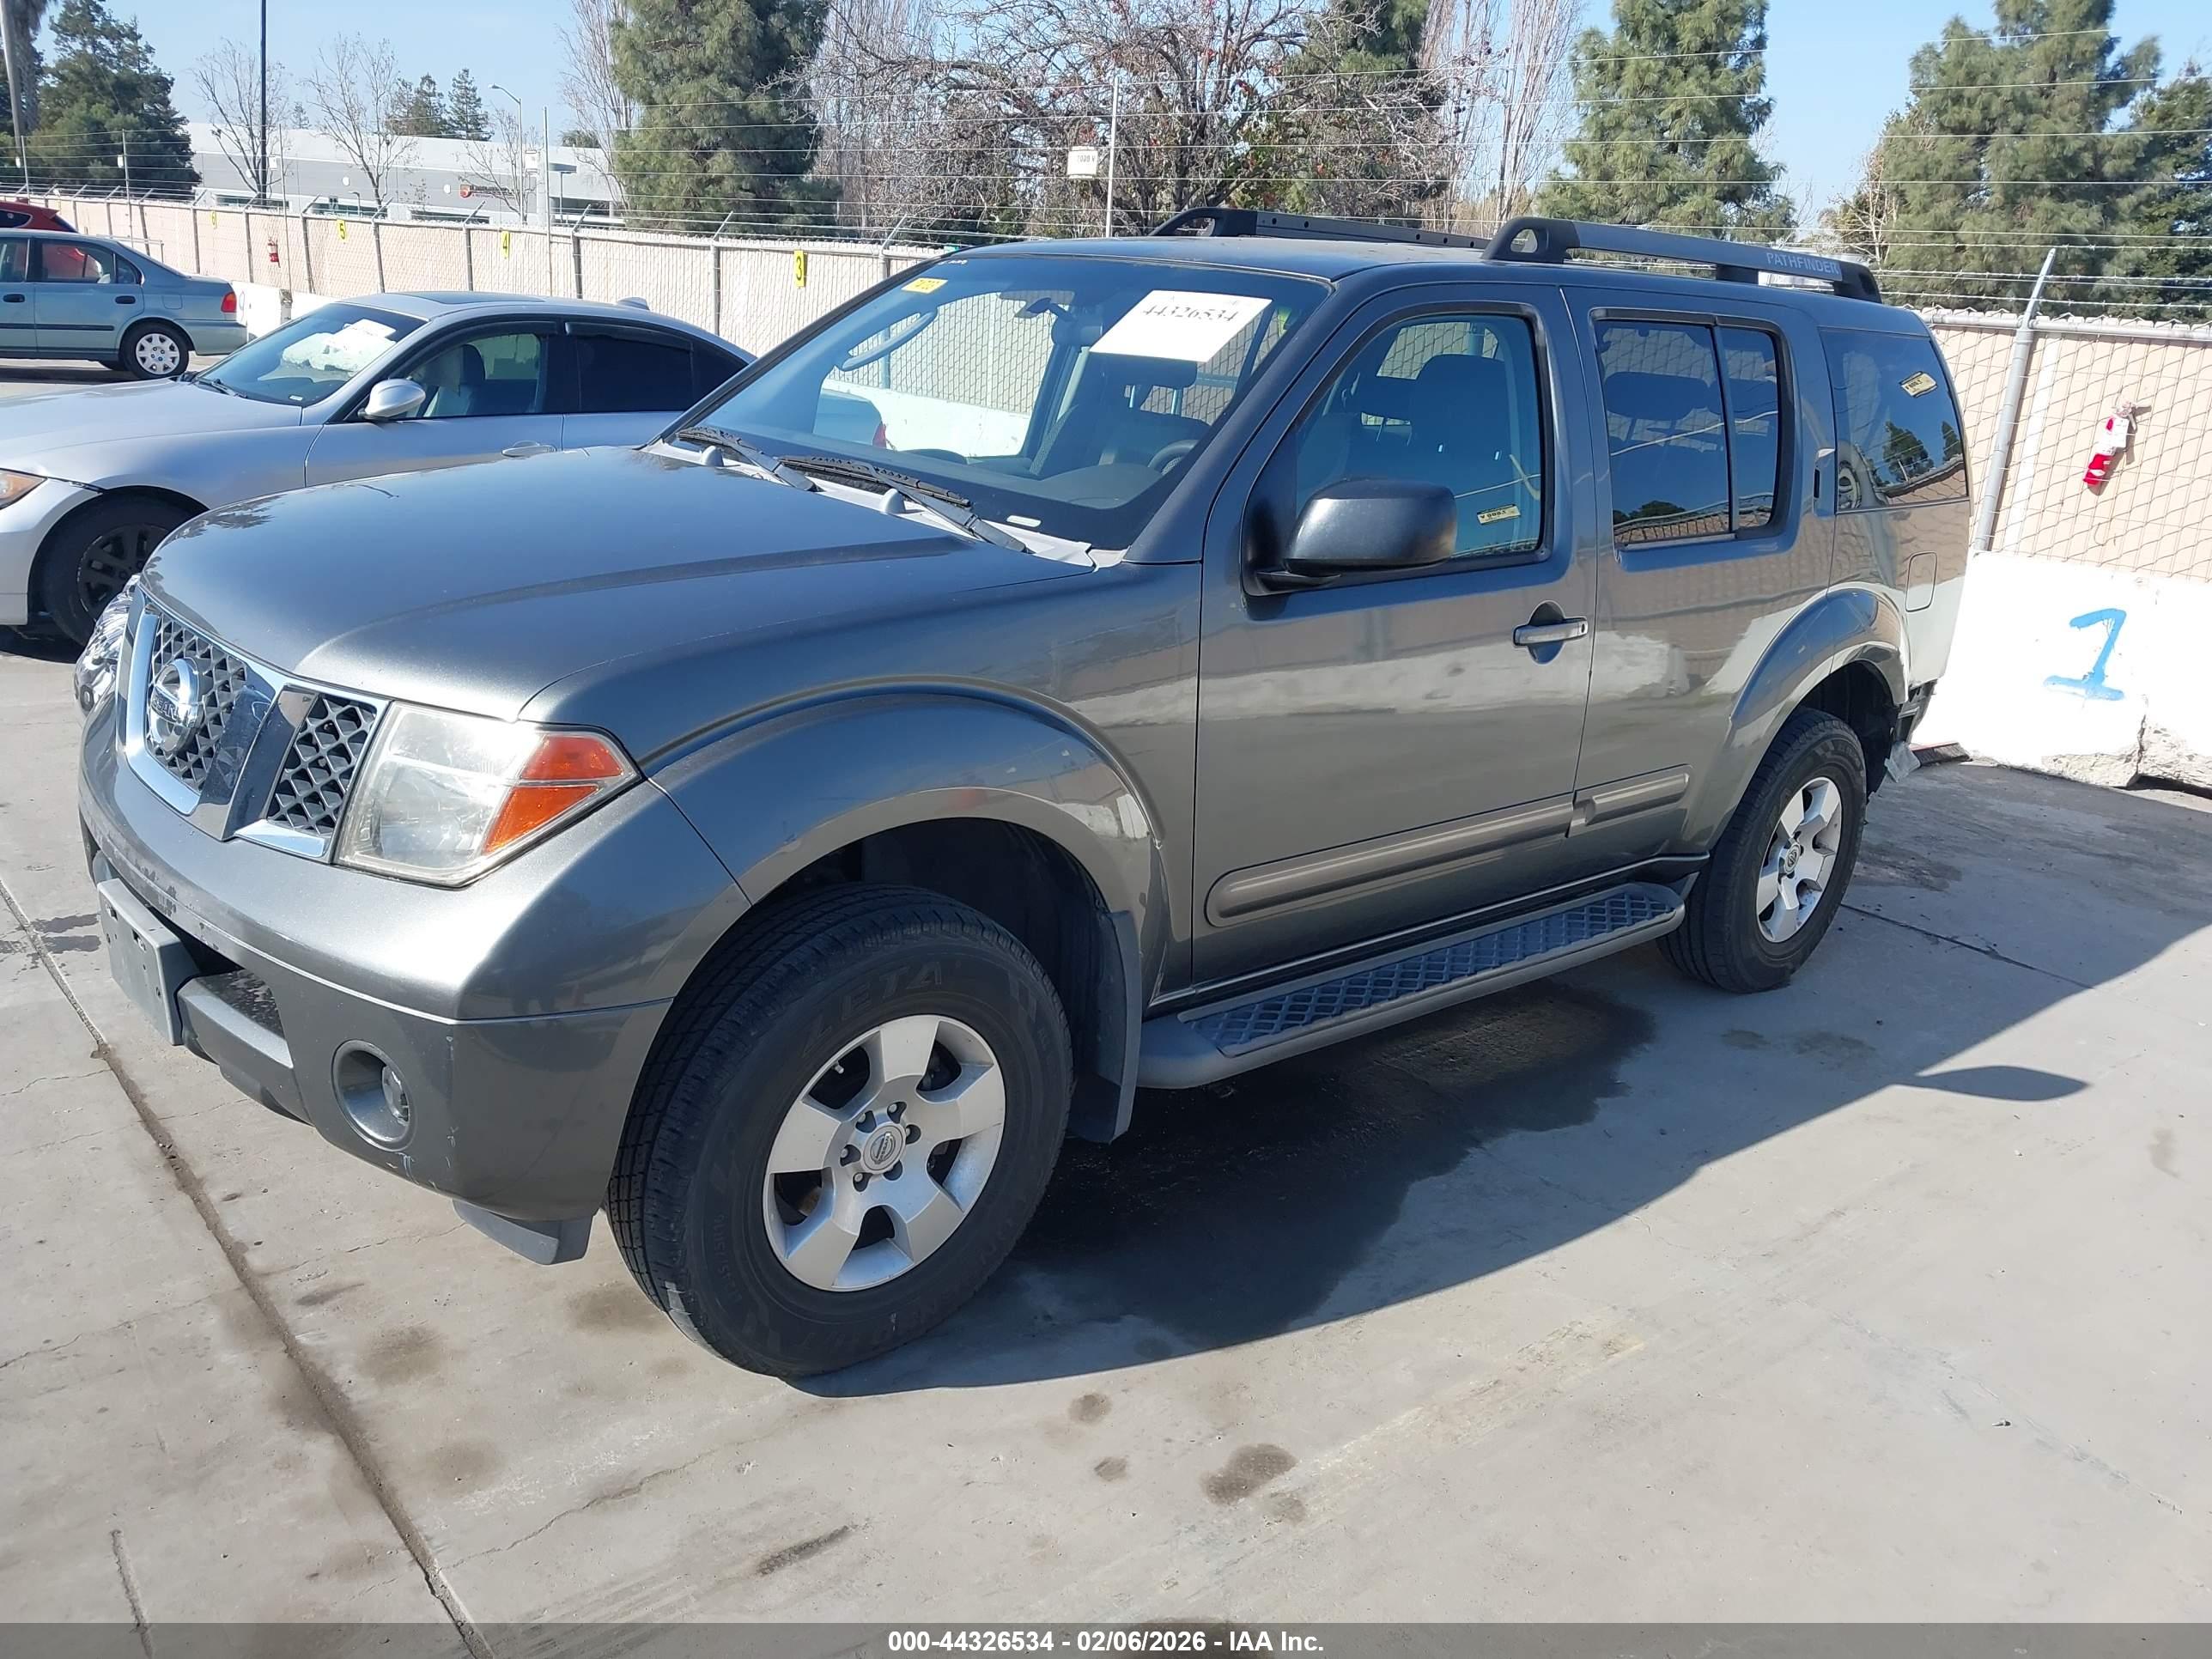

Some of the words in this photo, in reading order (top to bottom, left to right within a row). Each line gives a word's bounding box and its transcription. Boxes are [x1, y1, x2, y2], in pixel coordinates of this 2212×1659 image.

[339, 222, 345, 240] 5
[502, 233, 507, 253] 4
[796, 255, 802, 281] 3
[1766, 252, 1840, 274] PATHFINDER
[2043, 607, 2127, 701] 1
